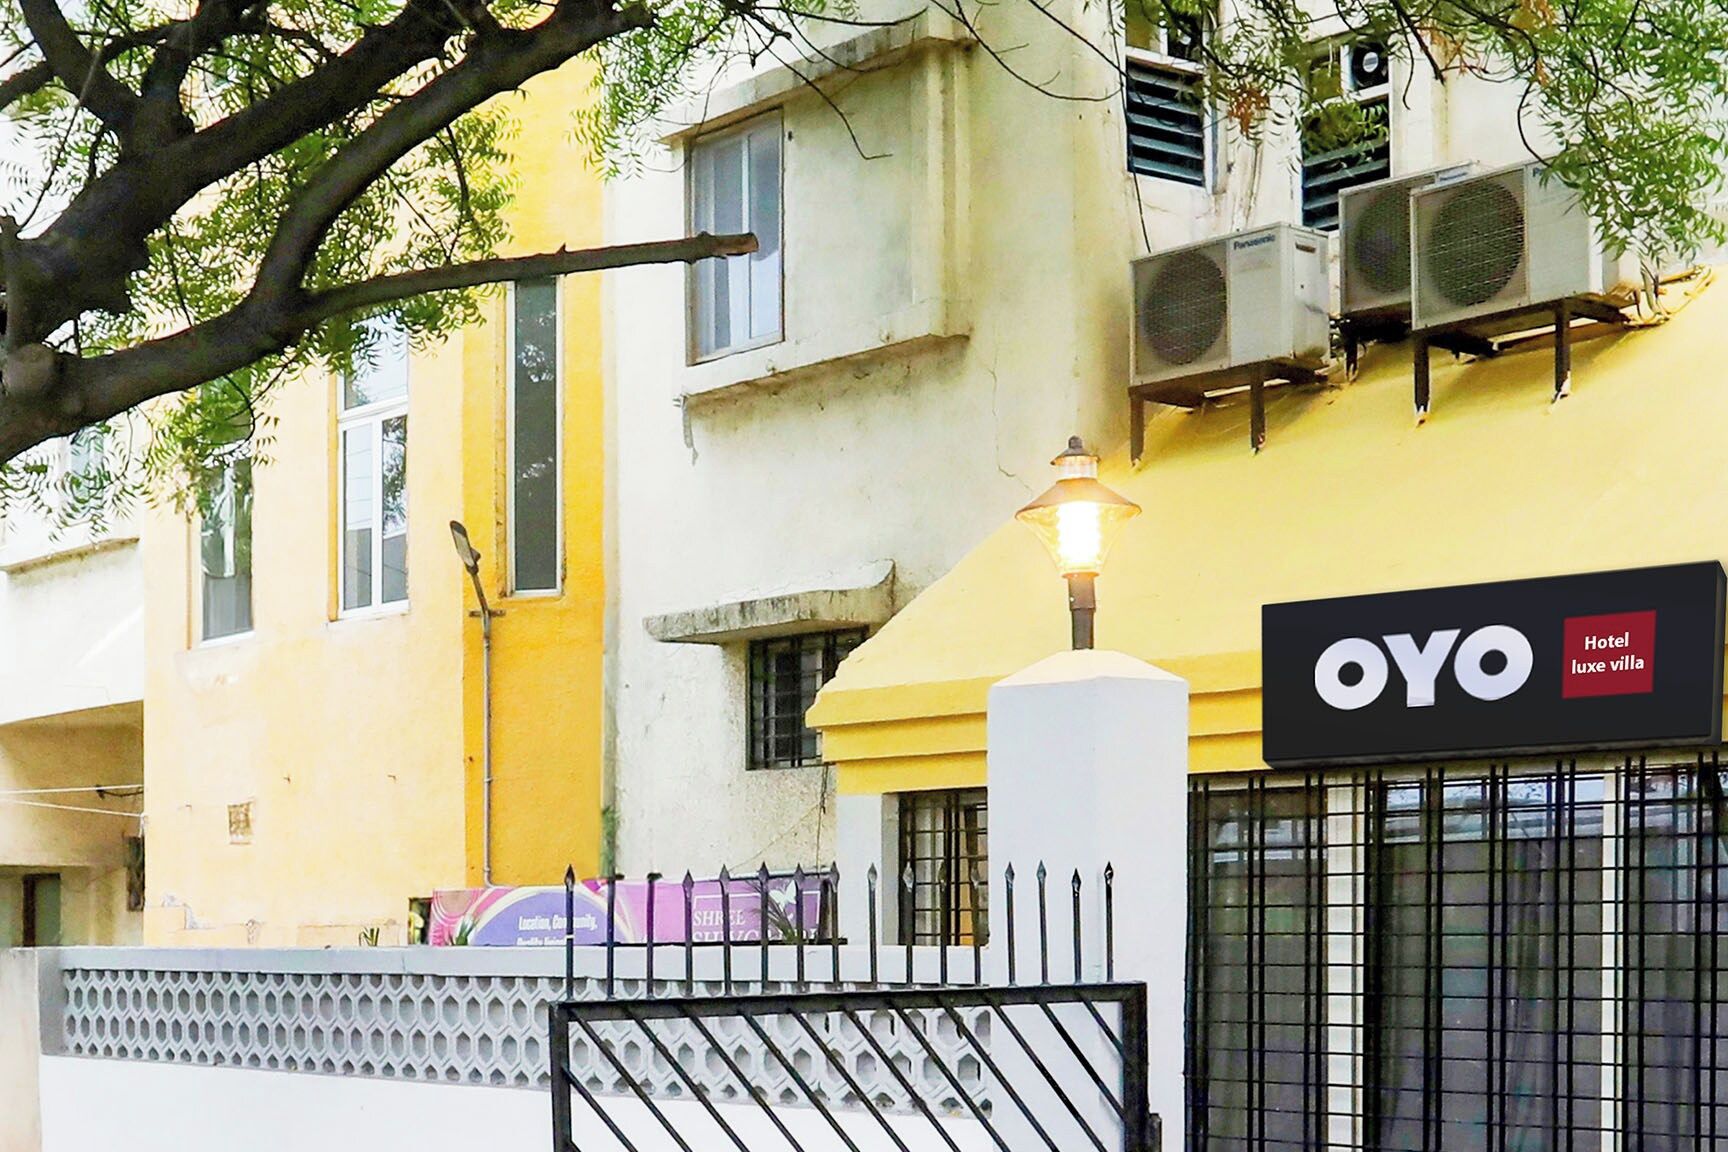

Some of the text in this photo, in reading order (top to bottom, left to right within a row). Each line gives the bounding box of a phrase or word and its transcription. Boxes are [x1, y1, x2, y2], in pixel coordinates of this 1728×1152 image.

[1584, 631, 1630, 650] Hotel
[1314, 624, 1534, 710] OYO
[1571, 654, 1645, 675] luxe villa
